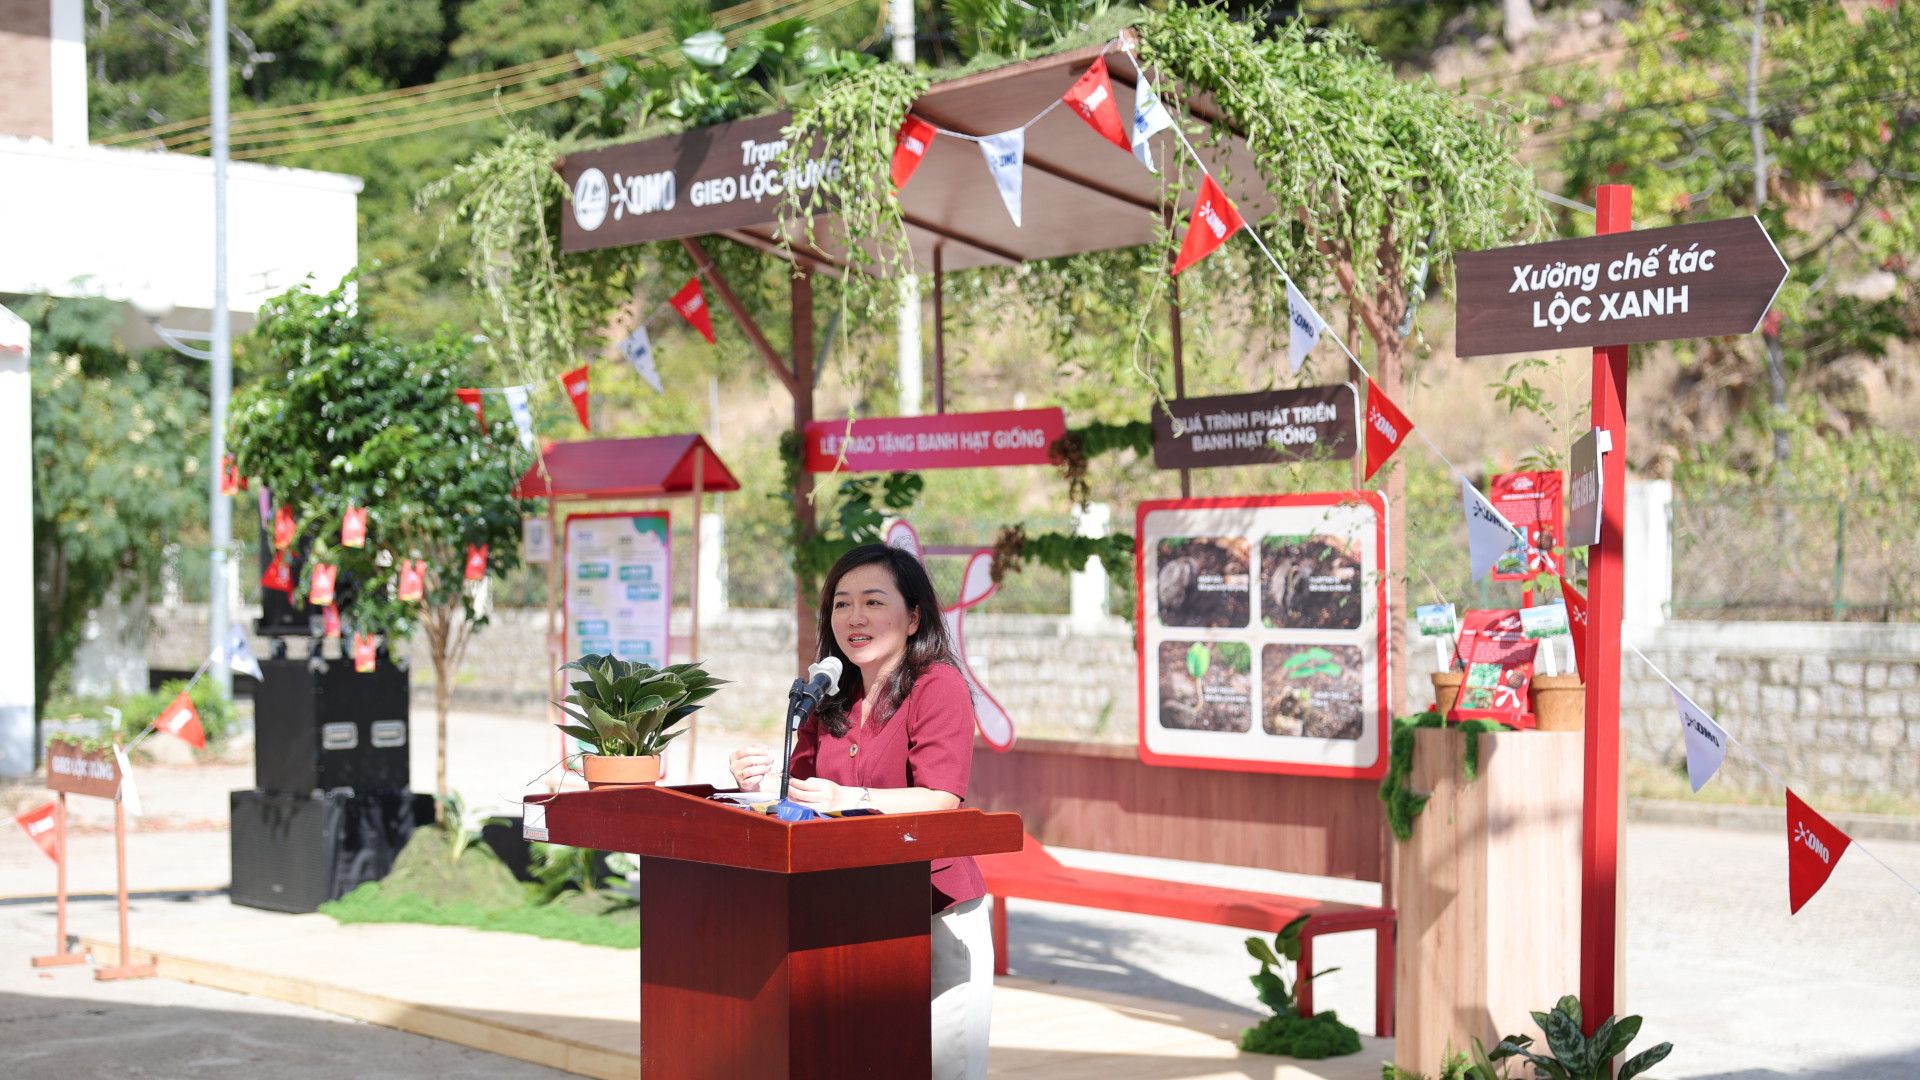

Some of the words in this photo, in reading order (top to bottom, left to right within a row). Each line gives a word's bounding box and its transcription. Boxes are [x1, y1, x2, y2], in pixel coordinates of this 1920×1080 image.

[630, 170, 676, 215] OMO
[689, 176, 737, 207] GIEO
[739, 165, 783, 203] LỘC
[1508, 262, 1600, 293] Xưởng
[1607, 243, 1668, 282] chế
[1667, 242, 1716, 273] tác
[1532, 291, 1592, 333] LỘC
[1598, 285, 1689, 322] XANH
[1204, 409, 1248, 431] TRÌNH
[1250, 405, 1290, 428] PHÁT
[917, 431, 959, 452] BANH
[960, 429, 991, 454] HẠT
[992, 425, 1045, 449] GIỐNG
[1192, 432, 1233, 452] BANH
[1234, 429, 1265, 452] HẠT
[1266, 424, 1317, 446] GIỐNG
[1805, 834, 1830, 864] OMO
